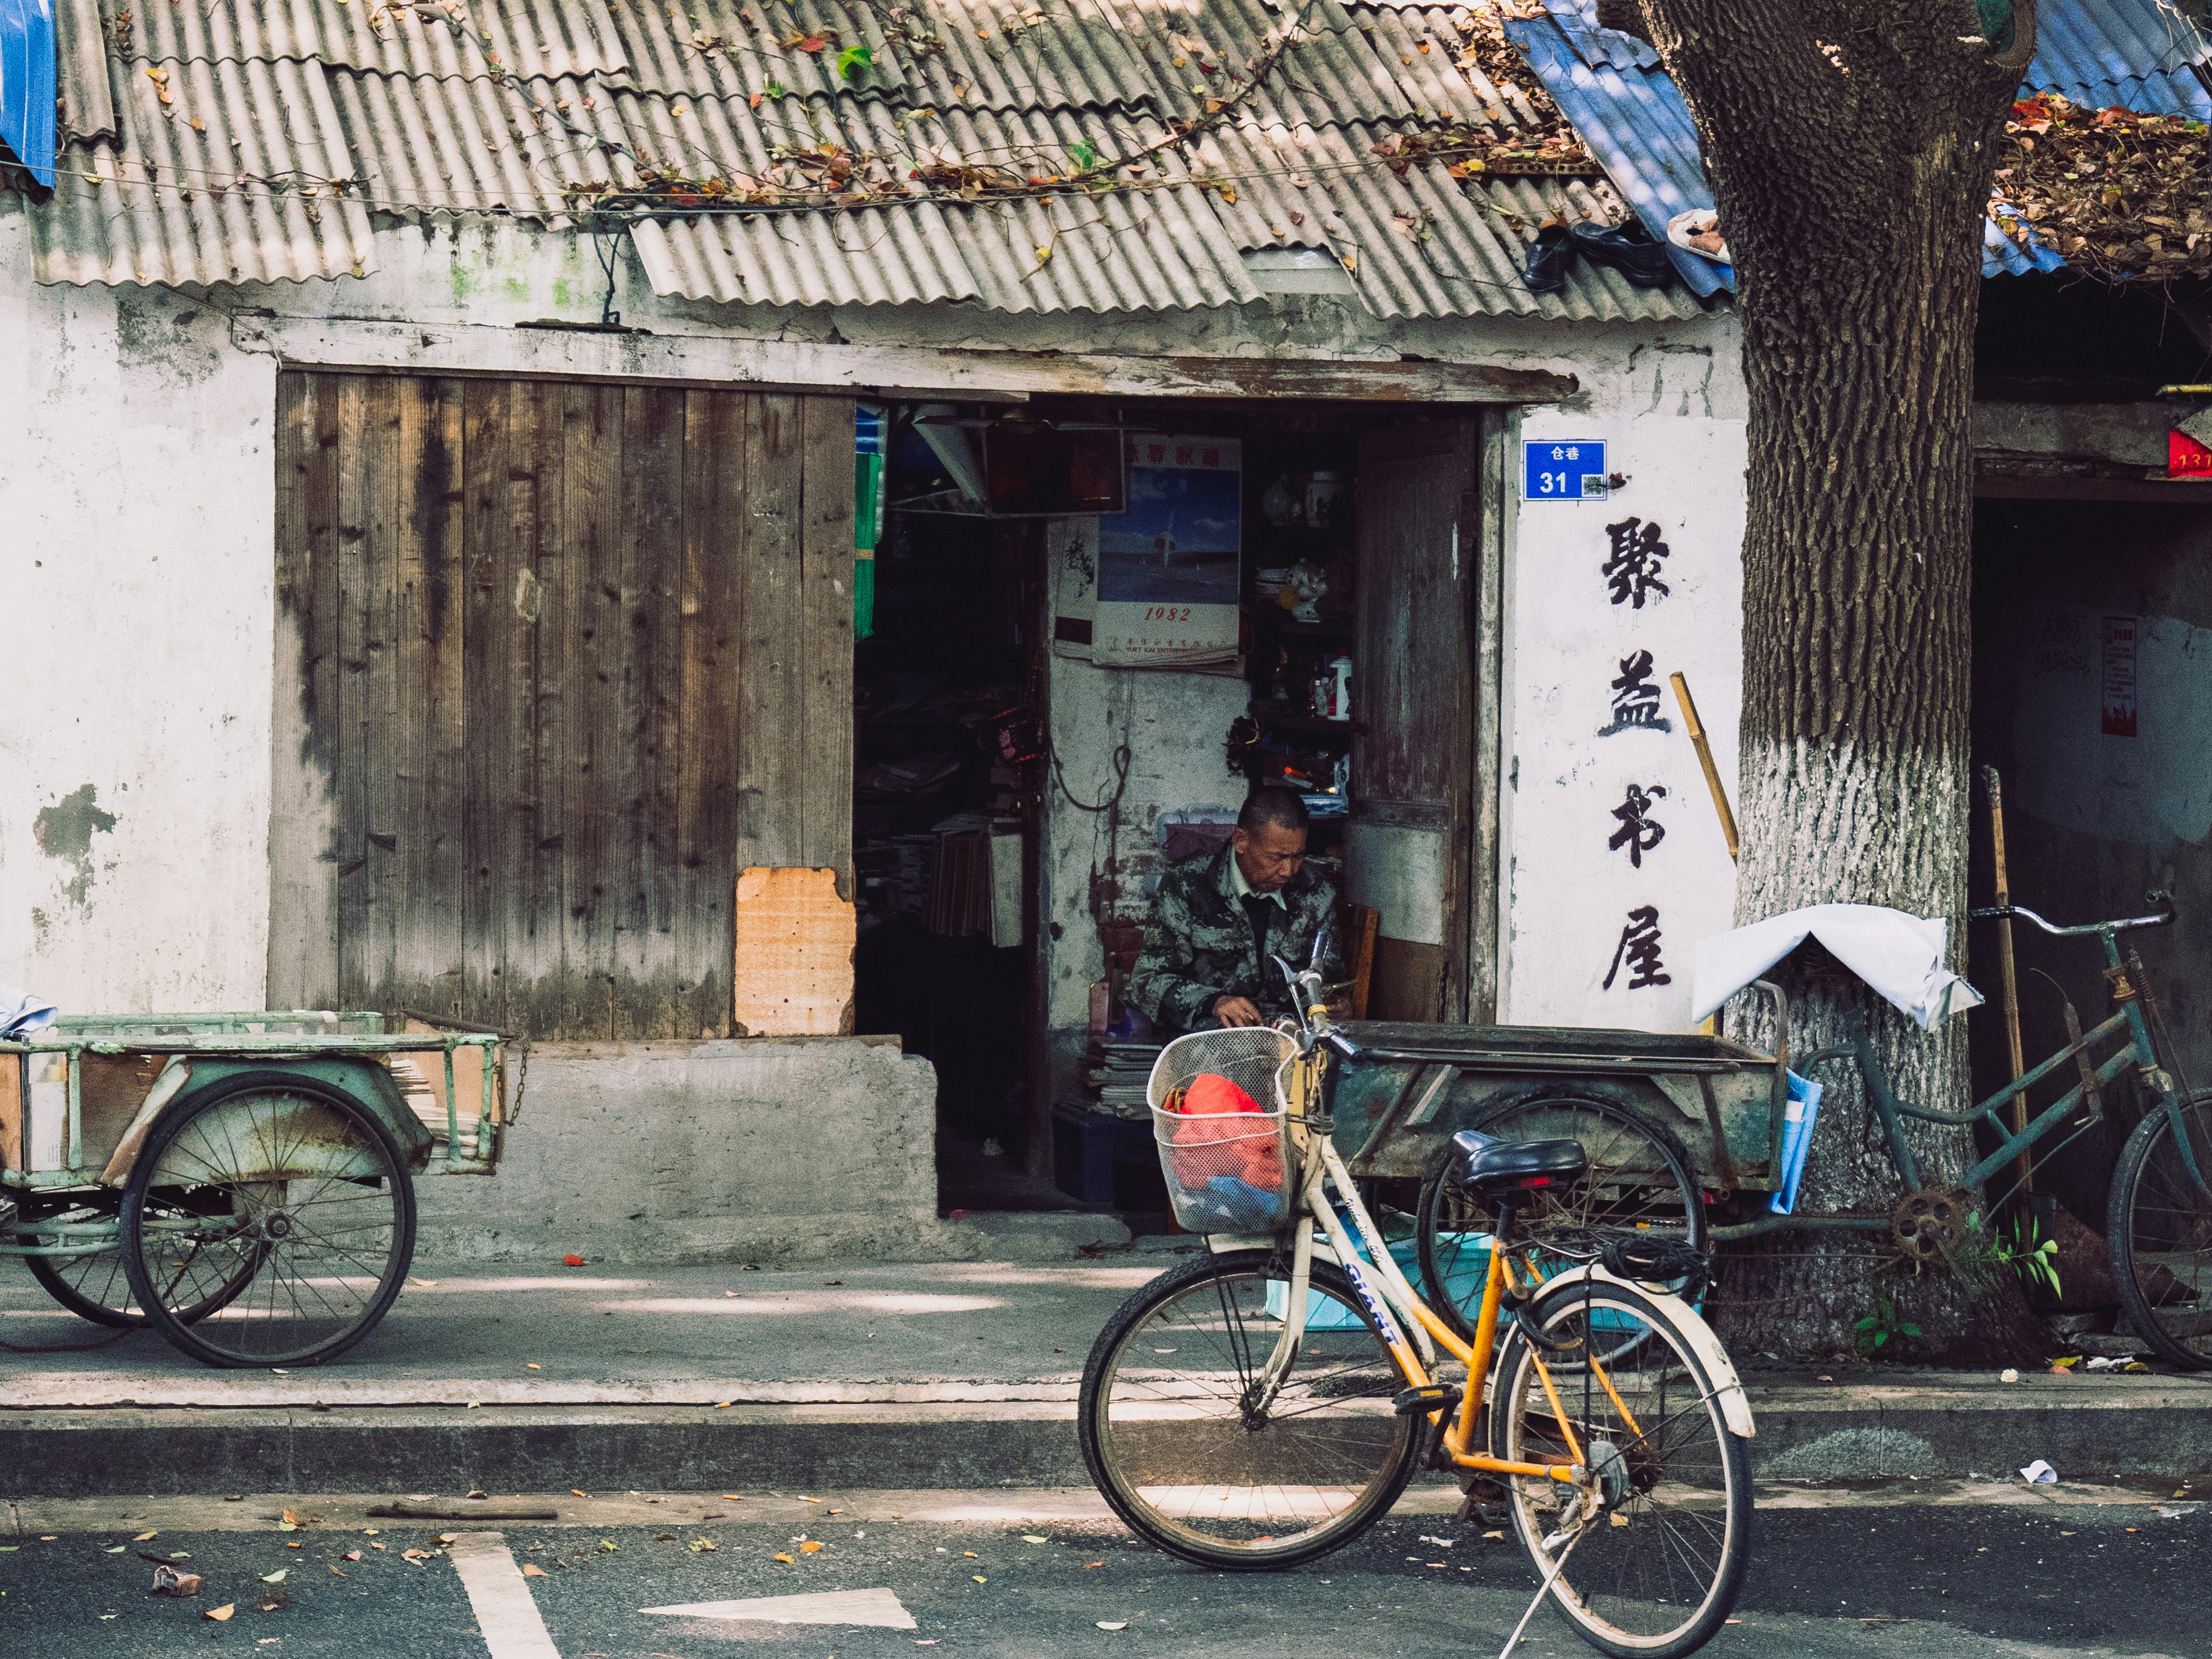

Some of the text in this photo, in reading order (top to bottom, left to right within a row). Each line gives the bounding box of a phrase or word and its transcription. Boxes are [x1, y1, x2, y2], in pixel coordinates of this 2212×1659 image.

[1551, 446, 1579, 461] 仓巷
[1540, 472, 1566, 493] 31
[1144, 607, 1191, 622] 1982
[1597, 516, 1672, 991] 聚益书屋
[1345, 1262, 1400, 1346] GIANT
